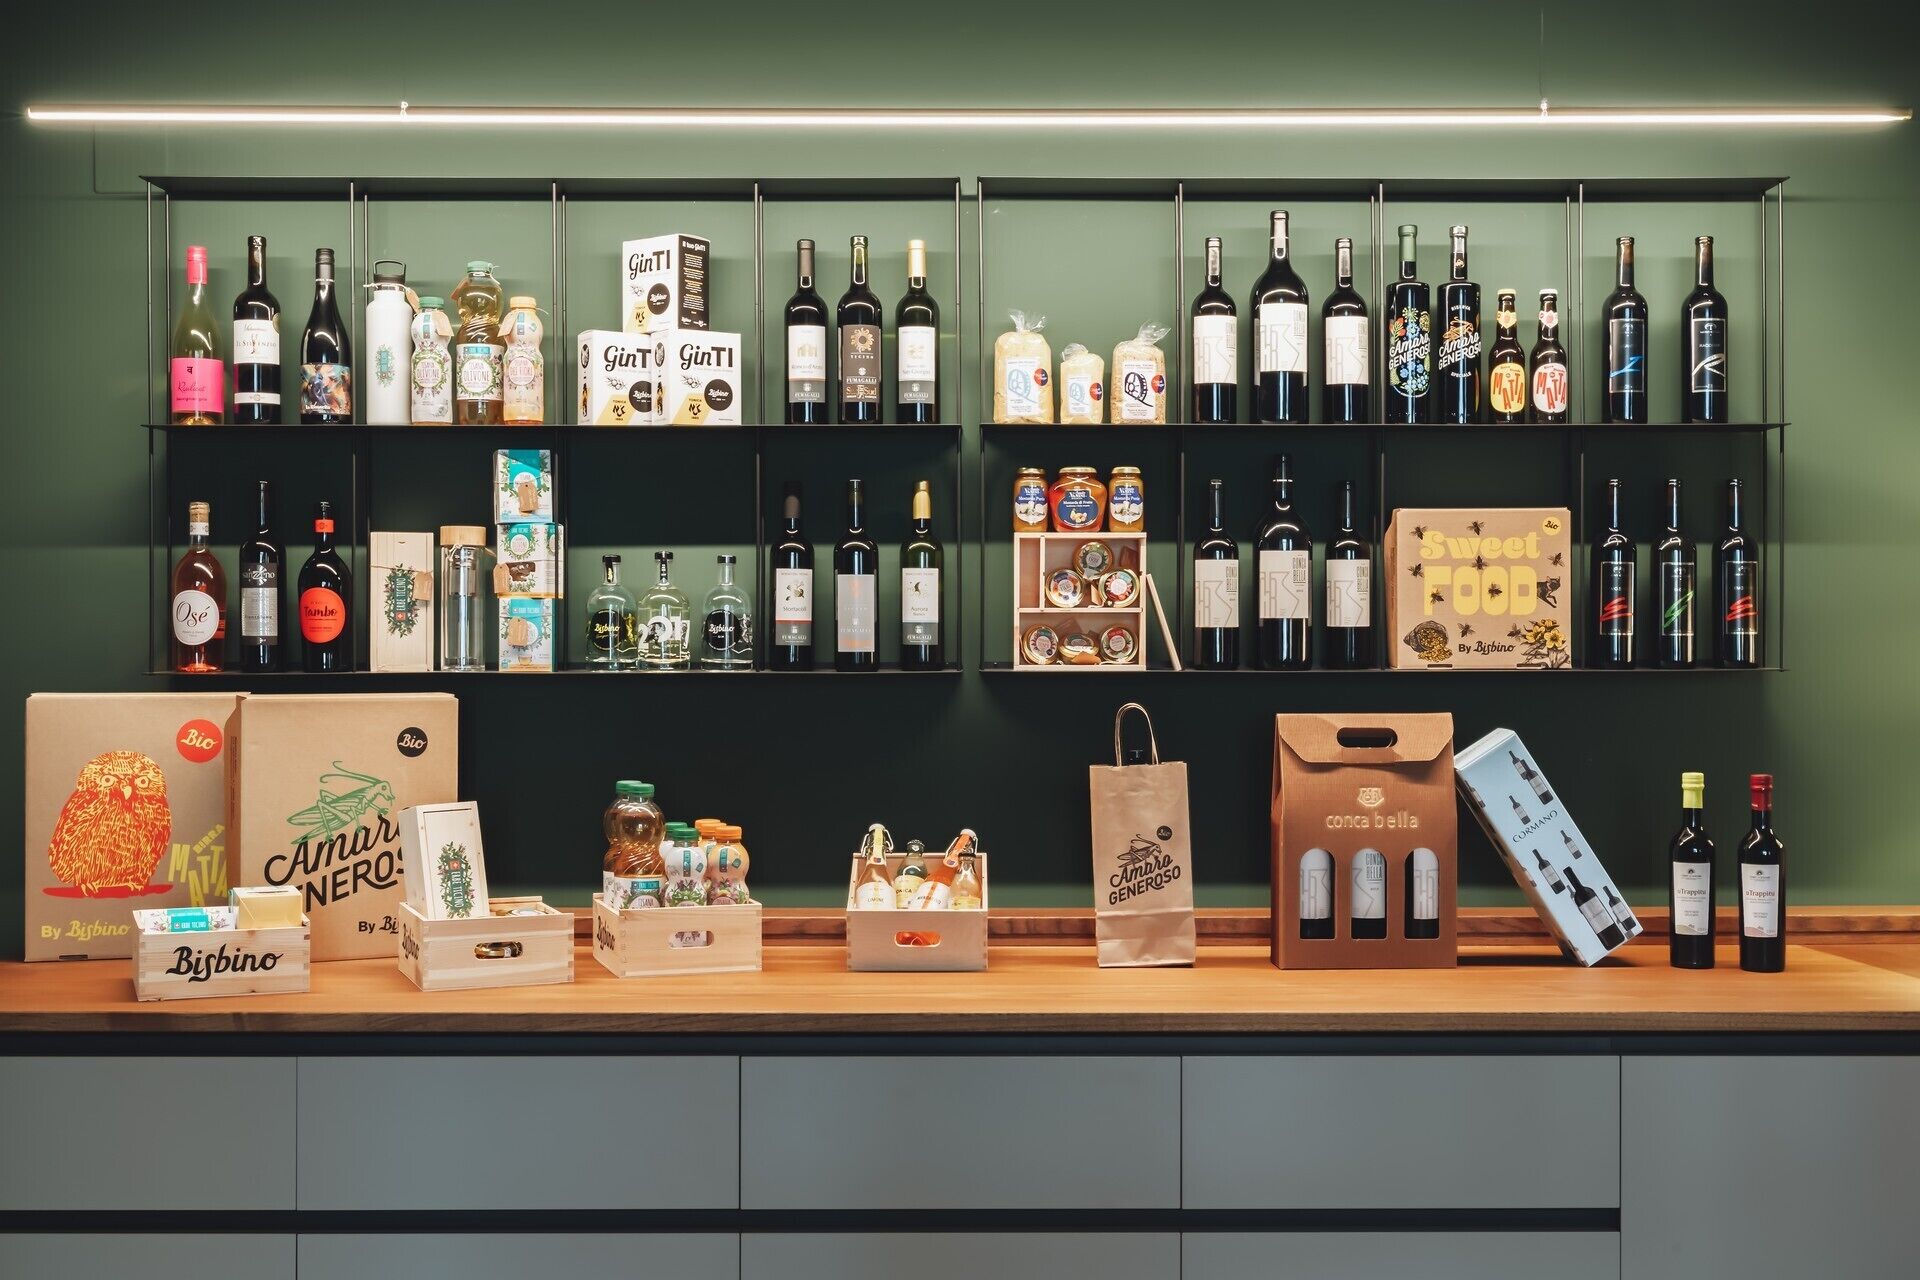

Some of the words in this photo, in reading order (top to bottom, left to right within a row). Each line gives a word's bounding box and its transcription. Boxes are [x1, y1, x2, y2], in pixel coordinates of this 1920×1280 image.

[629, 249, 671, 281] GinTI
[679, 342, 734, 371] GinTI
[1439, 332, 1480, 357] Amaro
[604, 345, 652, 372] GinT
[1544, 520, 1560, 530] Bio
[1419, 530, 1542, 560] Sweet
[1424, 565, 1538, 616] FOOD
[176, 601, 211, 628] Osé
[303, 605, 338, 618] Tambo
[1458, 643, 1472, 655] By
[1473, 640, 1517, 656] Bisbino
[180, 728, 219, 750] Bio
[398, 734, 427, 749] Bio
[1325, 813, 1370, 829] conca
[1374, 807, 1419, 829] bella
[1512, 810, 1559, 844] CORMANO
[263, 814, 402, 887] Amar
[1109, 854, 1174, 888] Amaro
[1108, 864, 1182, 906] GENEROSO
[41, 925, 62, 941] By
[66, 920, 131, 942] Bisbino
[358, 921, 376, 934] By
[165, 943, 285, 983] Bisbino
